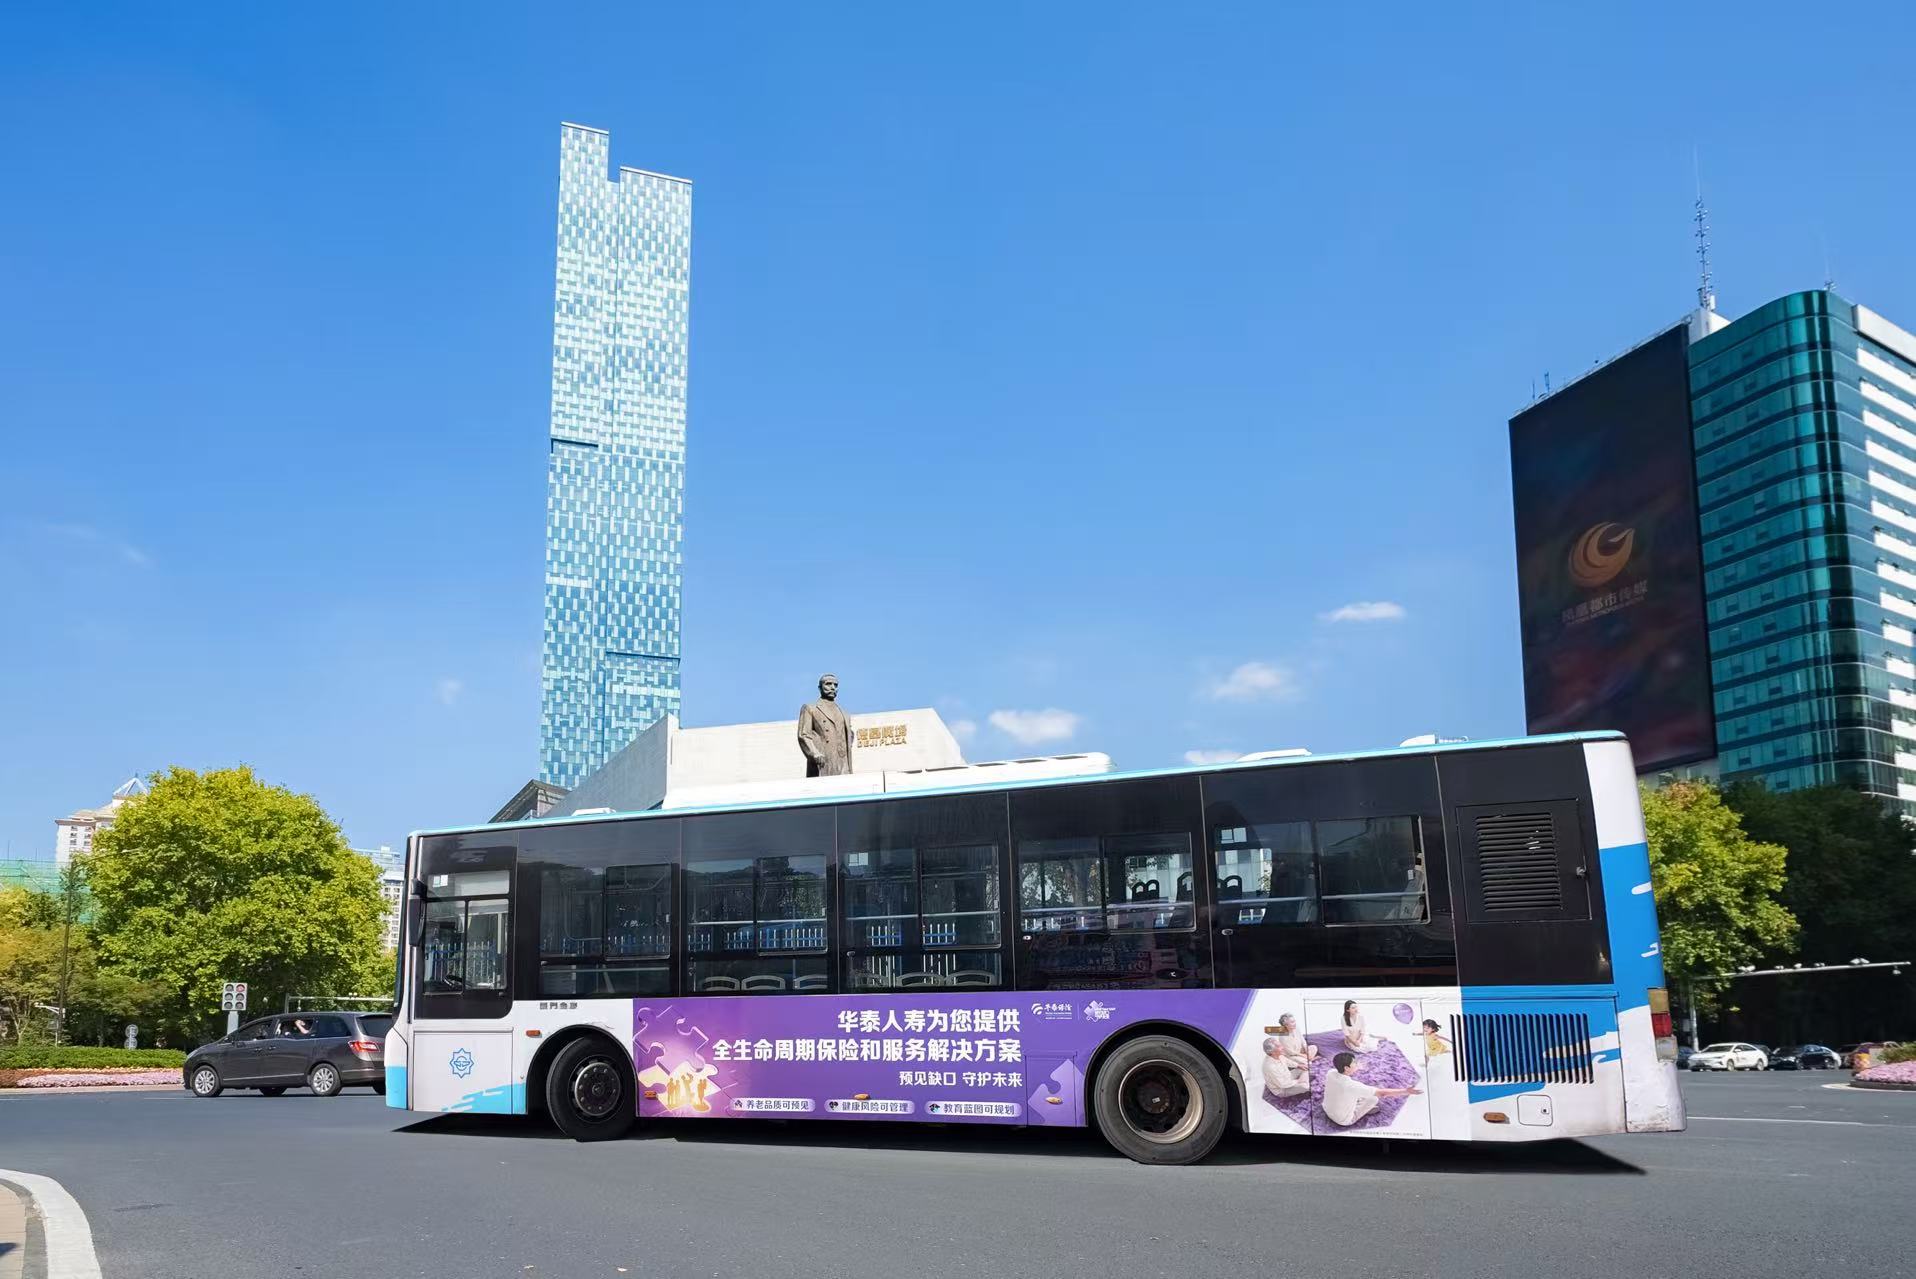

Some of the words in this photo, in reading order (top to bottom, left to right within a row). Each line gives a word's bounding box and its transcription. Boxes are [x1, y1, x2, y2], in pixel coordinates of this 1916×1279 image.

[880, 737, 907, 746] PLAZA
[837, 1008, 1021, 1033] 华泰人寿为您提供
[712, 1038, 1022, 1062] 全生命周期保险和服务解决方案
[899, 1071, 957, 1086] 预见缺口
[962, 1072, 1023, 1087] 守护未来
[746, 1099, 810, 1110] 养老品质可预见
[841, 1101, 909, 1112] 健康风险可管理
[943, 1103, 1015, 1115] 教育蓝图可规划
